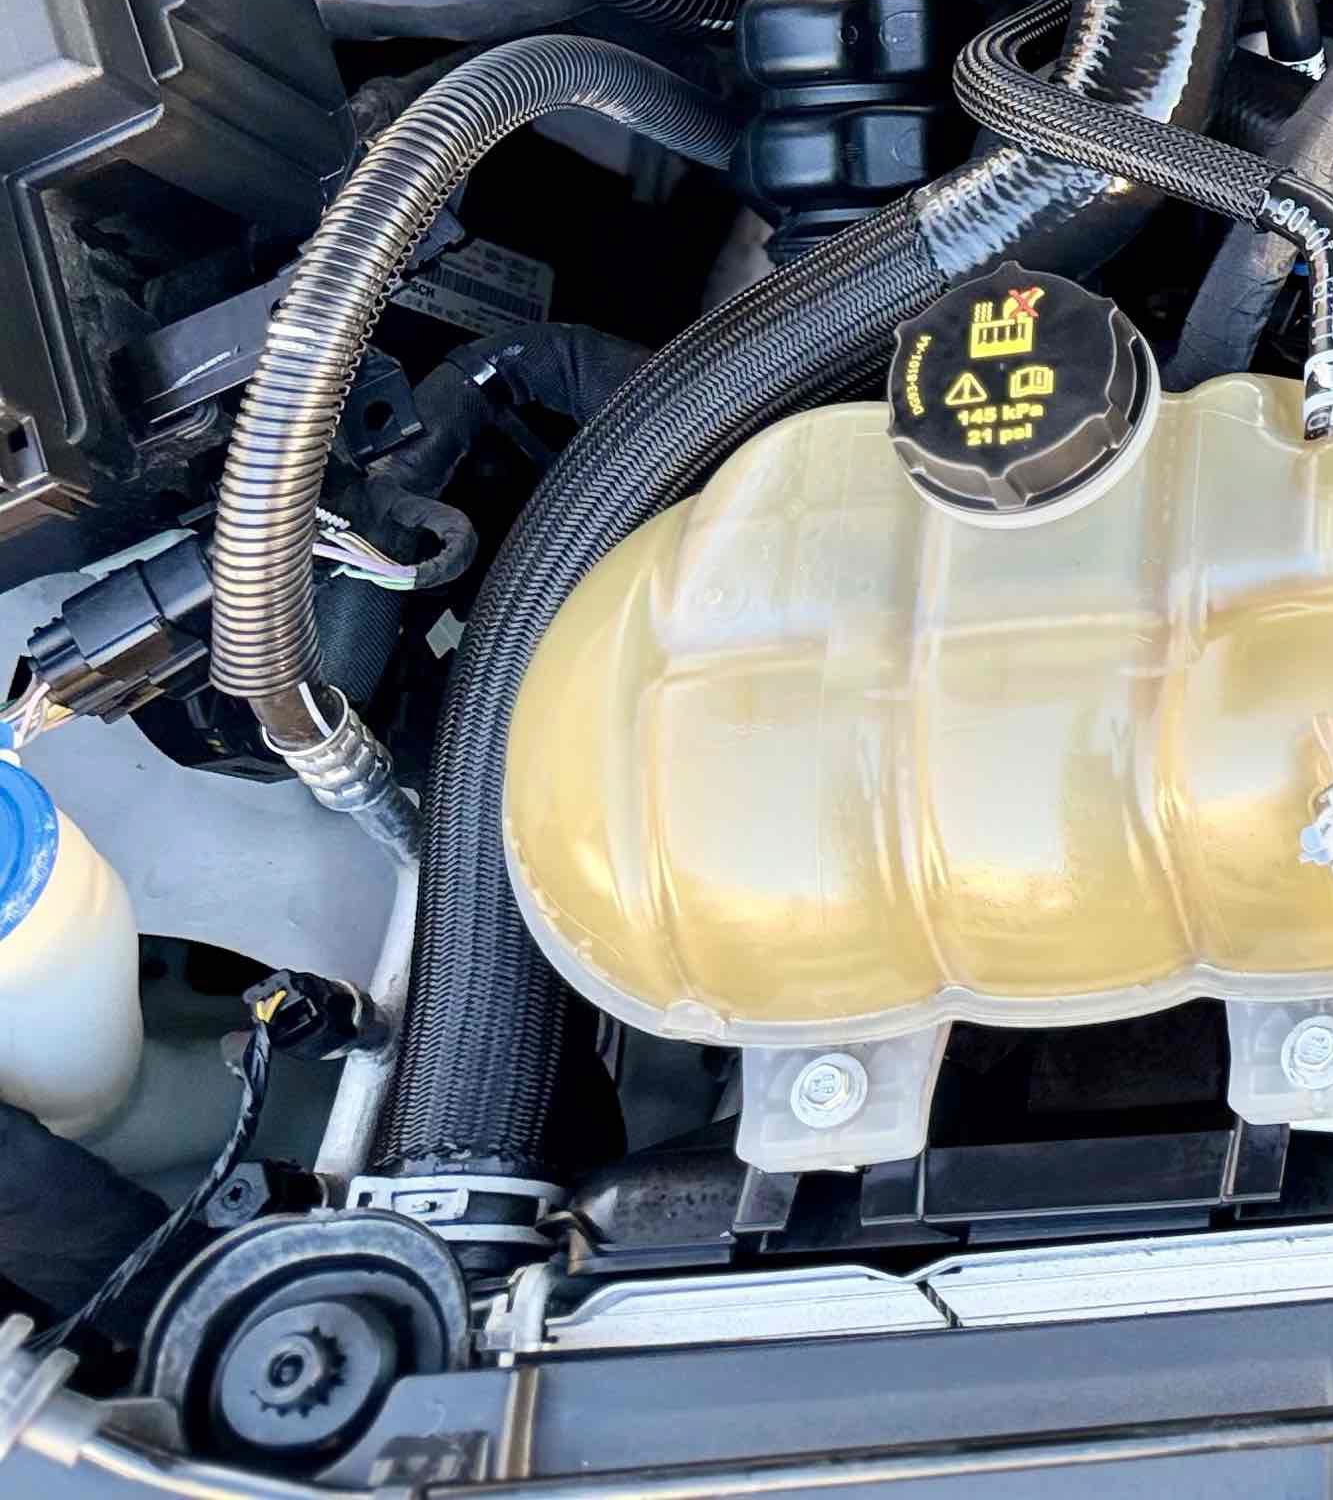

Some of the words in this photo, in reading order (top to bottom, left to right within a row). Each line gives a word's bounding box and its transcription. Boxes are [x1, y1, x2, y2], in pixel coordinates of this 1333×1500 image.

[957, 406, 997, 426] 145
[1002, 403, 1043, 421] kPa
[967, 428, 992, 446] 21
[1000, 423, 1032, 445] psi
